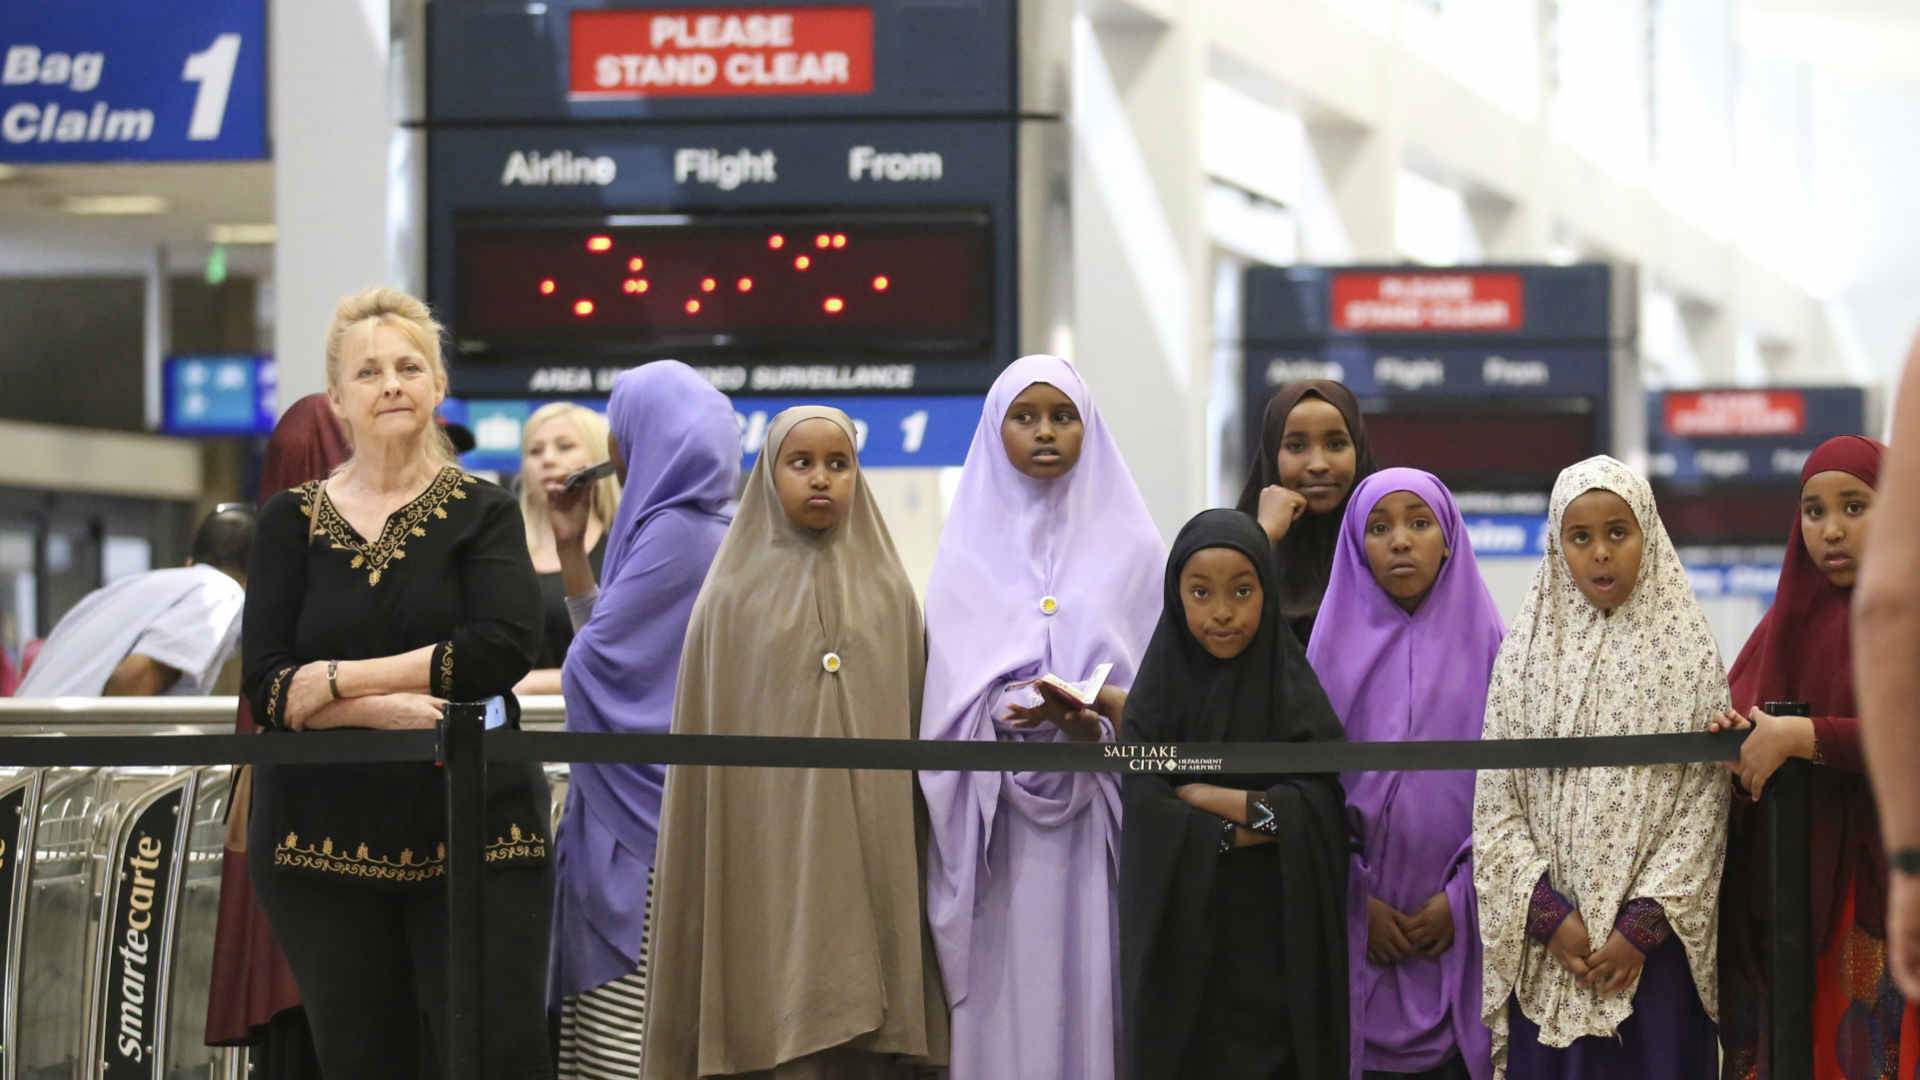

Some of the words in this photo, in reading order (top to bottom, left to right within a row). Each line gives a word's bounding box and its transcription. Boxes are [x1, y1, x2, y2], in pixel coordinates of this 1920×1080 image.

[651, 14, 793, 49] PLEASE
[3, 44, 104, 92] Bag
[595, 53, 717, 87] STAND
[725, 51, 850, 85] CLEAR
[182, 32, 242, 141] 1
[3, 101, 155, 144] Claim
[502, 150, 616, 186] Airline
[675, 148, 778, 191] Flight
[848, 145, 943, 182] From
[530, 366, 592, 392] AREA
[1104, 745, 1138, 757] SALT
[1141, 745, 1177, 758] LAKE
[1129, 759, 1166, 771] CITY
